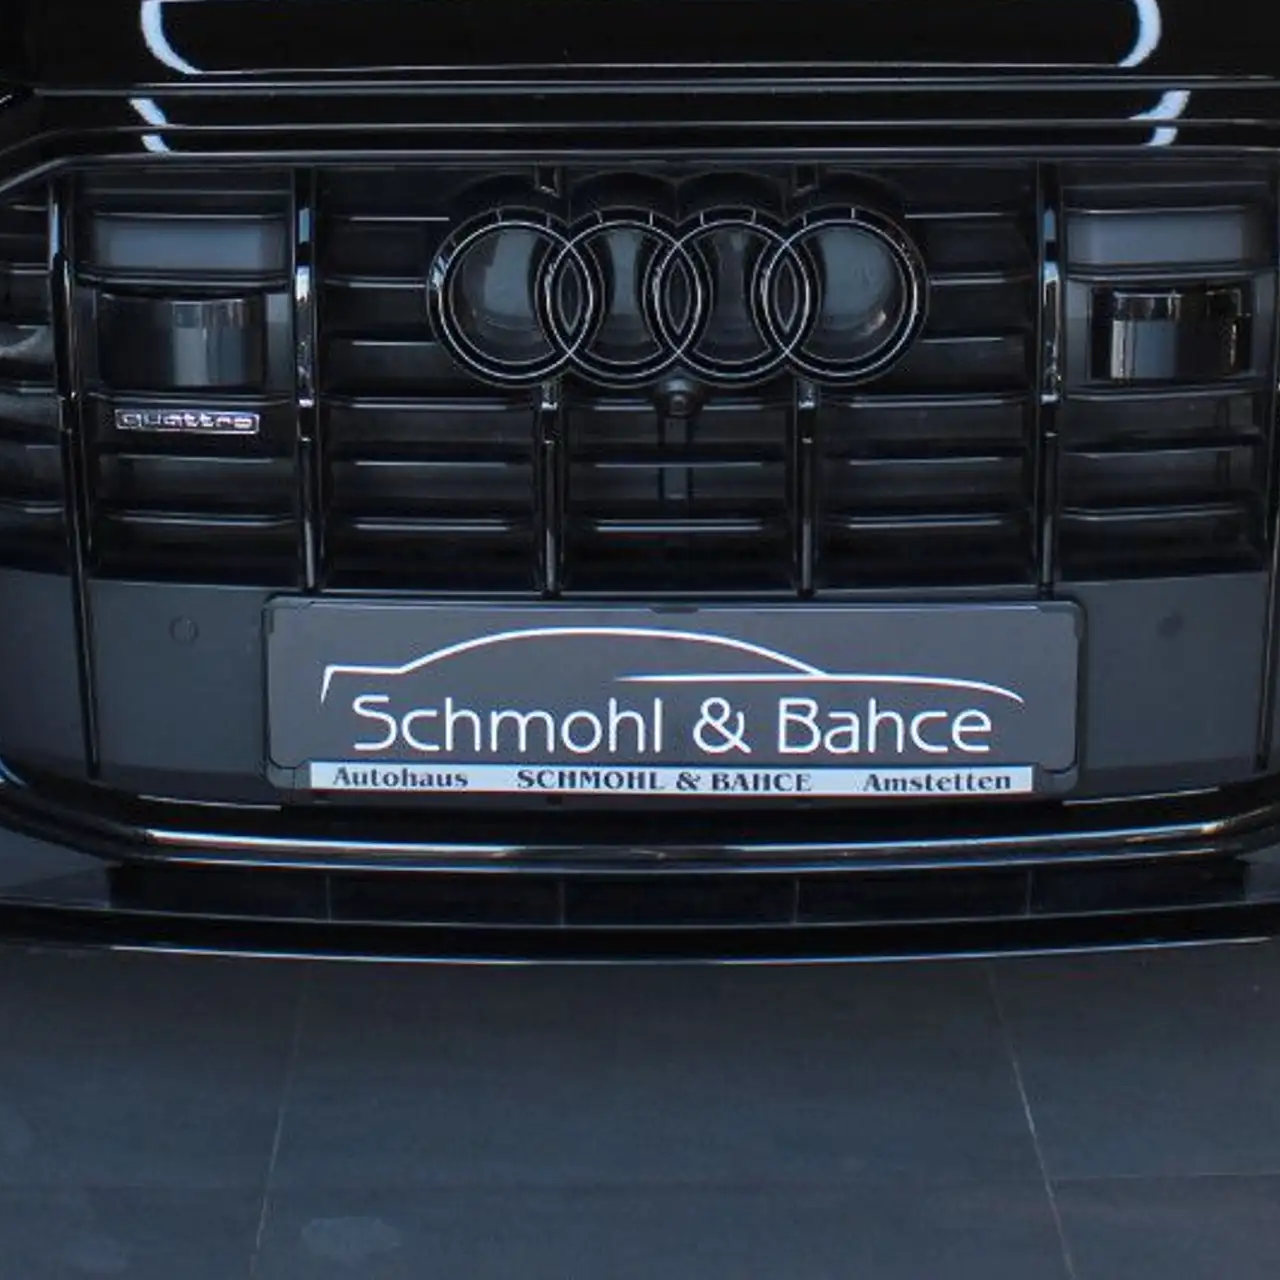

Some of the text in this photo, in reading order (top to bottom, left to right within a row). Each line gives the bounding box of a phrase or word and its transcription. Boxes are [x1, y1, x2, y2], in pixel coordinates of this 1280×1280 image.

[121, 411, 254, 430] quattro
[352, 693, 993, 754] Schmohl & Bahce
[332, 764, 1013, 793] Autohaus SCHMOHL & BAHCE Amstetten
